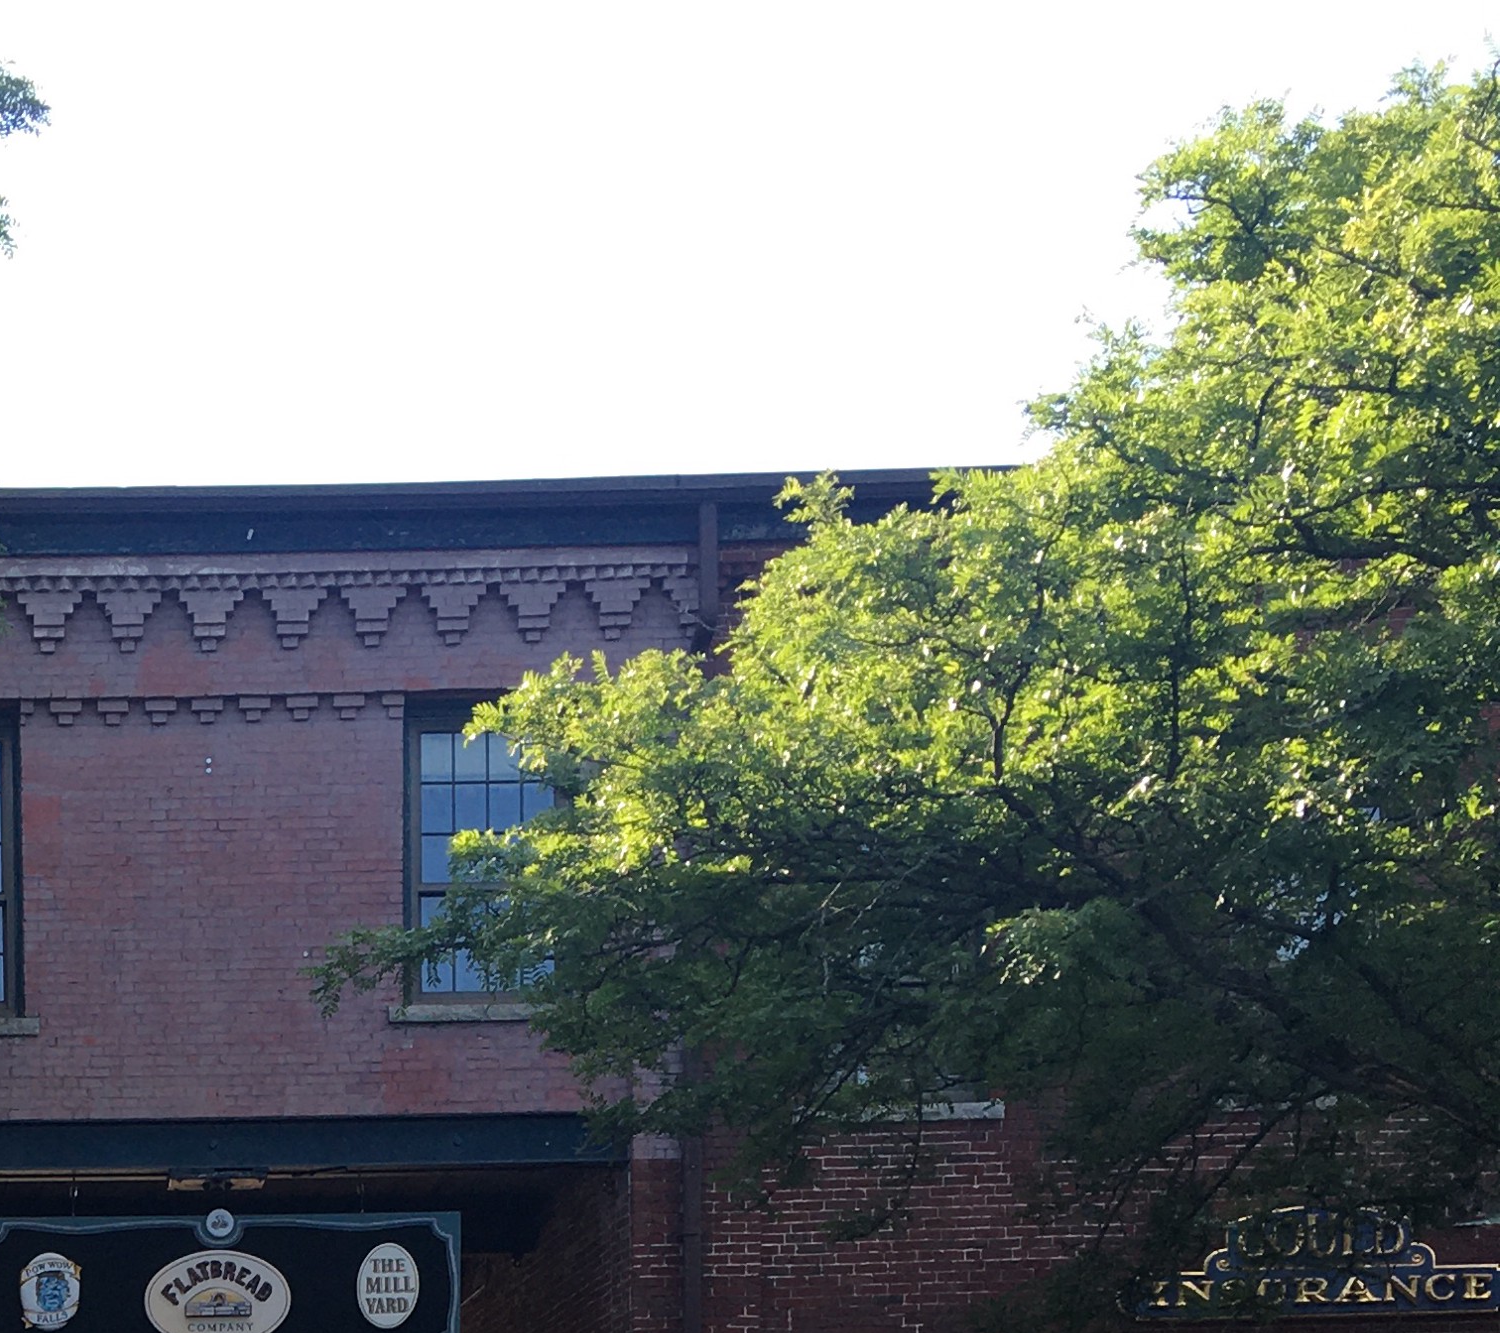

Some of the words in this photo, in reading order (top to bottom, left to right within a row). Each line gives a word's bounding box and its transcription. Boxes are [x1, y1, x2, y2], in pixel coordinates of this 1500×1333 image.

[369, 1258, 406, 1273] THE
[160, 1260, 273, 1306] FLATBREAD
[365, 1276, 416, 1294] MILL
[365, 1297, 410, 1314] YARD
[36, 1311, 69, 1324] FALLS
[187, 1322, 254, 1333] COMPANY
